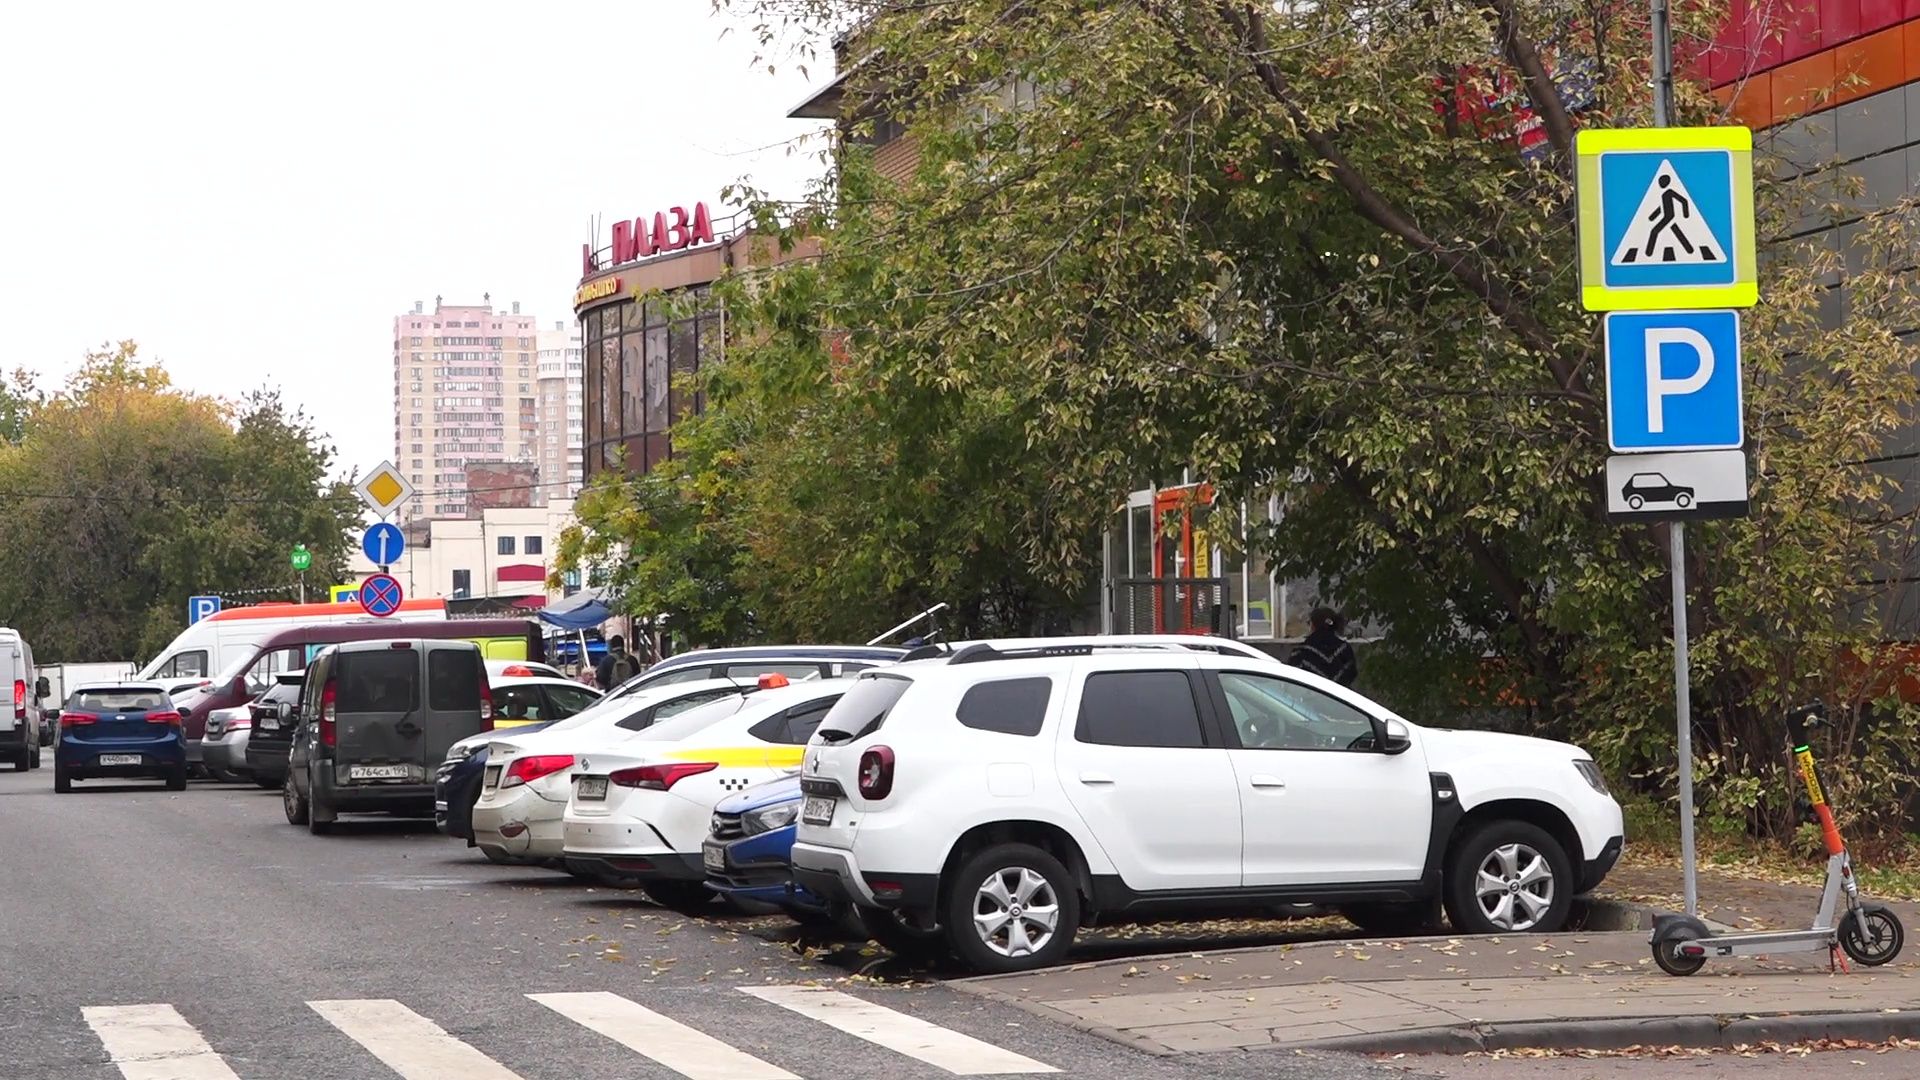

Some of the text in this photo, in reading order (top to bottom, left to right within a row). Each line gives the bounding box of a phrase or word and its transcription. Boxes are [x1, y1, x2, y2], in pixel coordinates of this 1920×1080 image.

[612, 201, 714, 266] ПЛАЗА
[1645, 327, 1714, 433] P
[293, 555, 309, 565] KF
[198, 600, 216, 621] P
